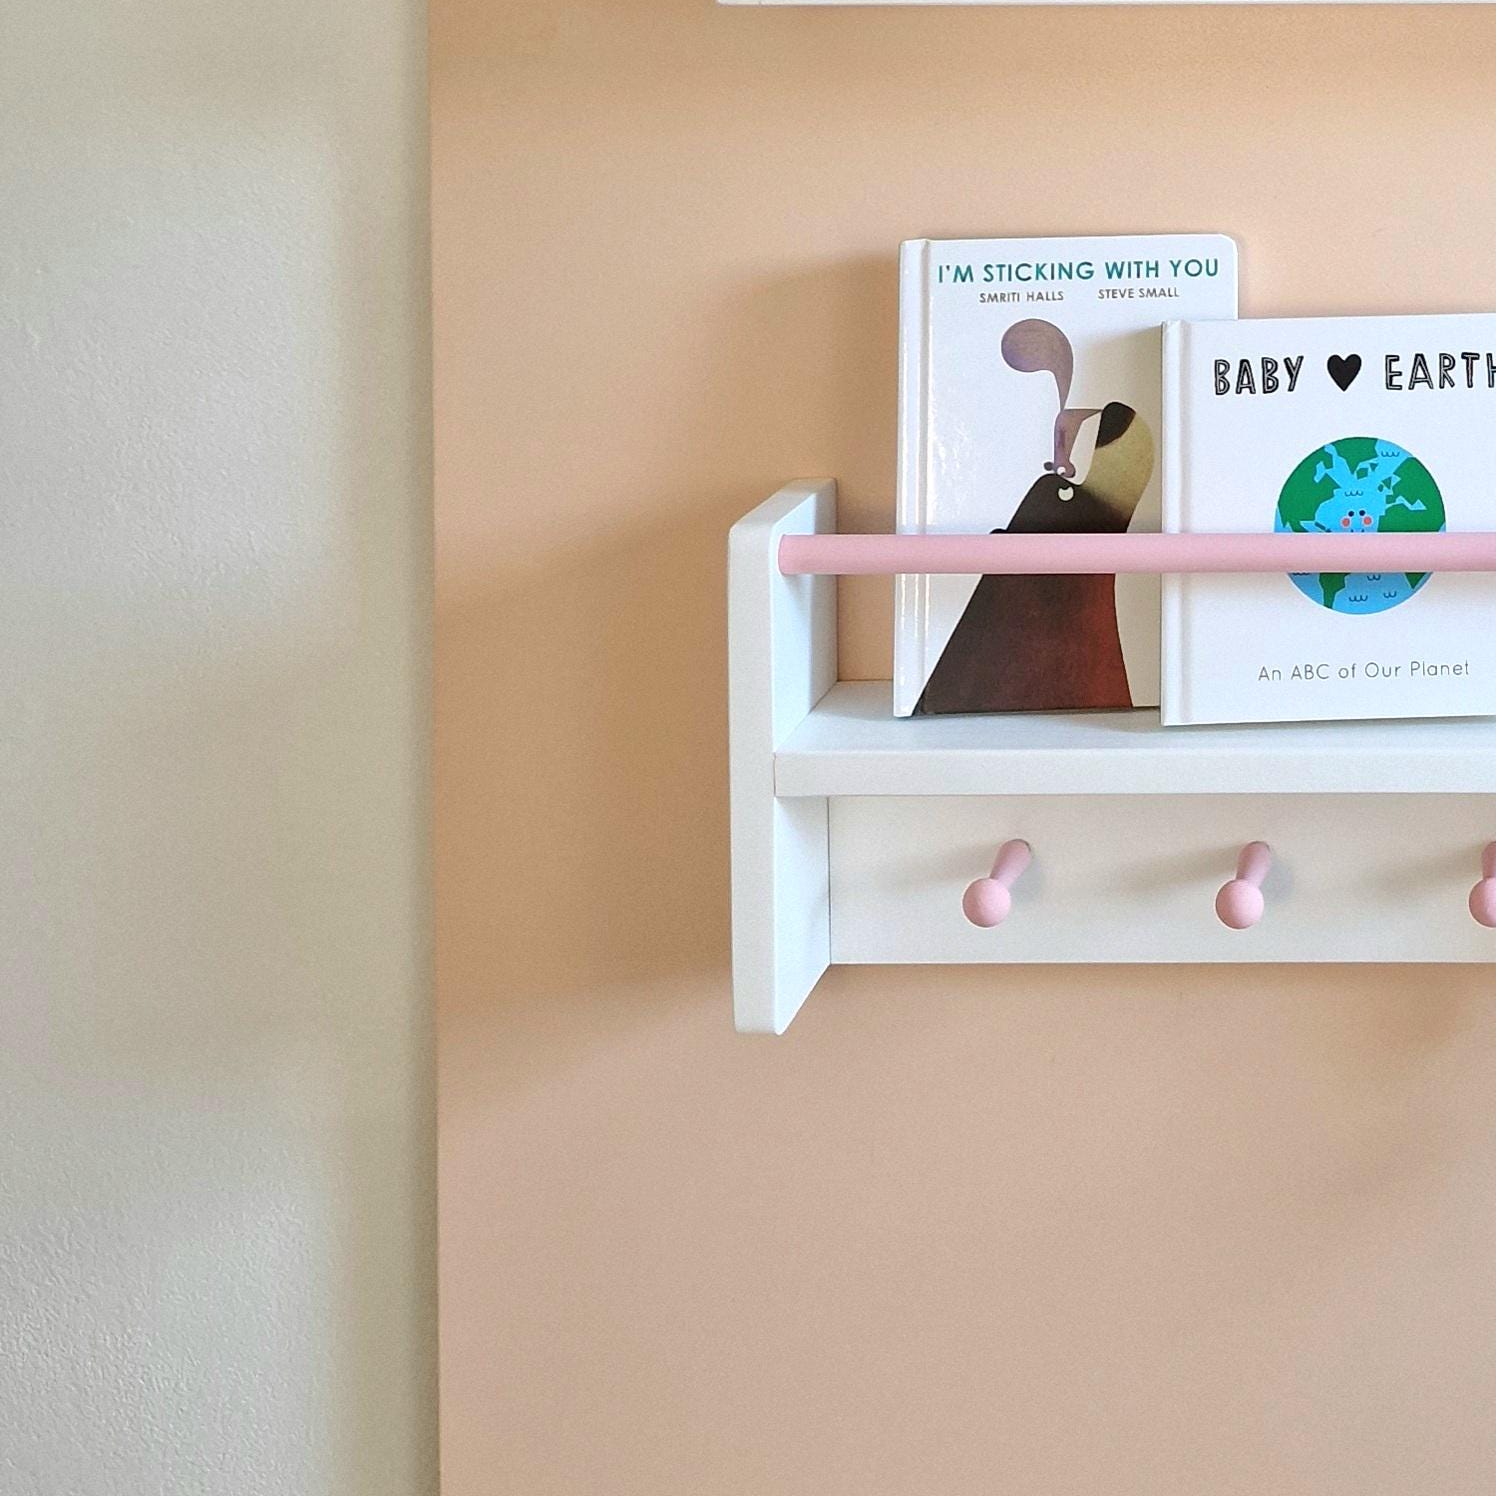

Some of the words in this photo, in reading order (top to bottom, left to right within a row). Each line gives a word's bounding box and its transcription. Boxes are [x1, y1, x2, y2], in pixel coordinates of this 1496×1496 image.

[937, 263, 975, 284] I'M
[982, 260, 1095, 283] STICKING
[1104, 259, 1160, 280] WITH
[1168, 258, 1219, 278] YOU
[979, 291, 1021, 303] SMRITI
[1026, 290, 1065, 302] HALLS
[1098, 288, 1135, 300] STEVE
[1138, 287, 1180, 299] SMALL
[1213, 354, 1305, 396] BABY
[1258, 665, 1282, 681] An
[1290, 663, 1331, 680] ABC
[1337, 662, 1358, 679] of
[1364, 661, 1402, 678] Our
[1410, 659, 1470, 677] Planet
